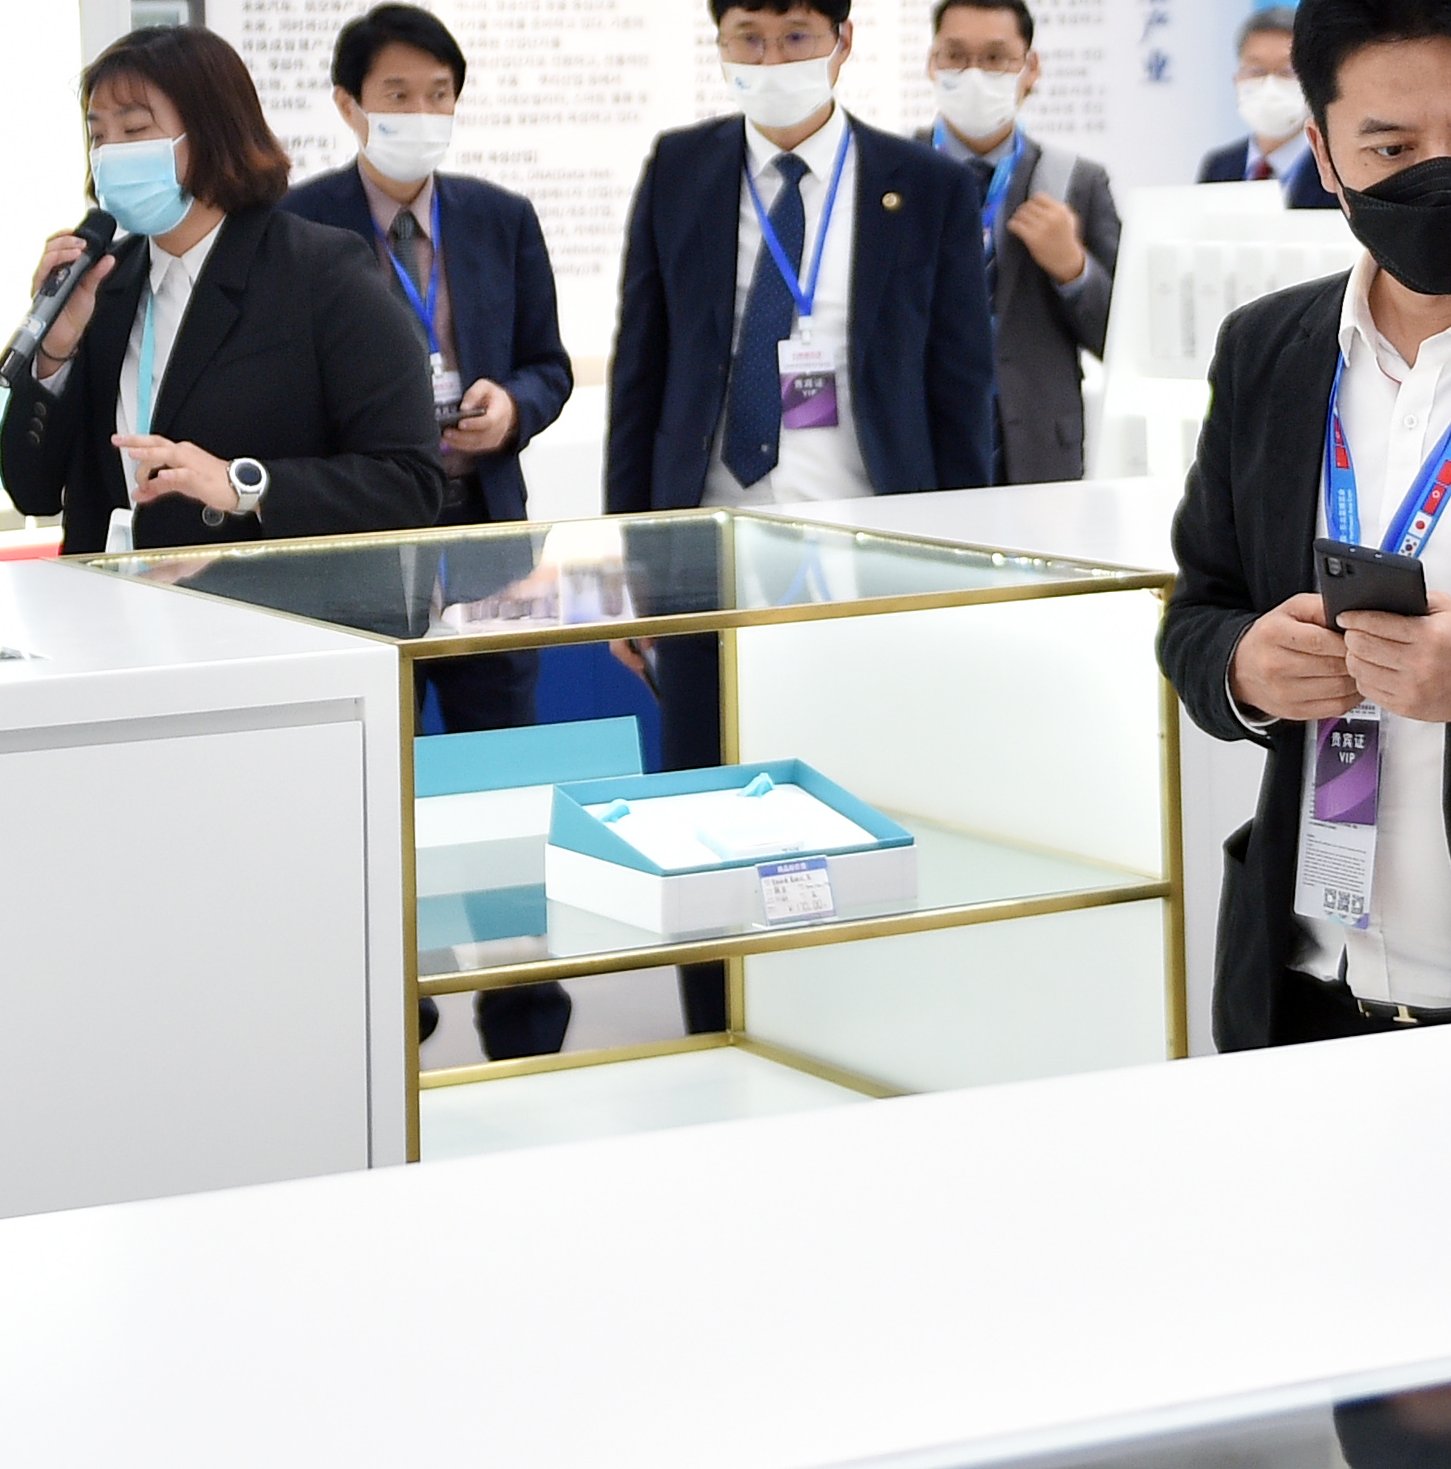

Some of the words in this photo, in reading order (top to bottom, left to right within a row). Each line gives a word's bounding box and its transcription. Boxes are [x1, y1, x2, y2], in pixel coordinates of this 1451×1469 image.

[1330, 731, 1366, 749] 贵宾证
[1338, 752, 1356, 764] VIP
